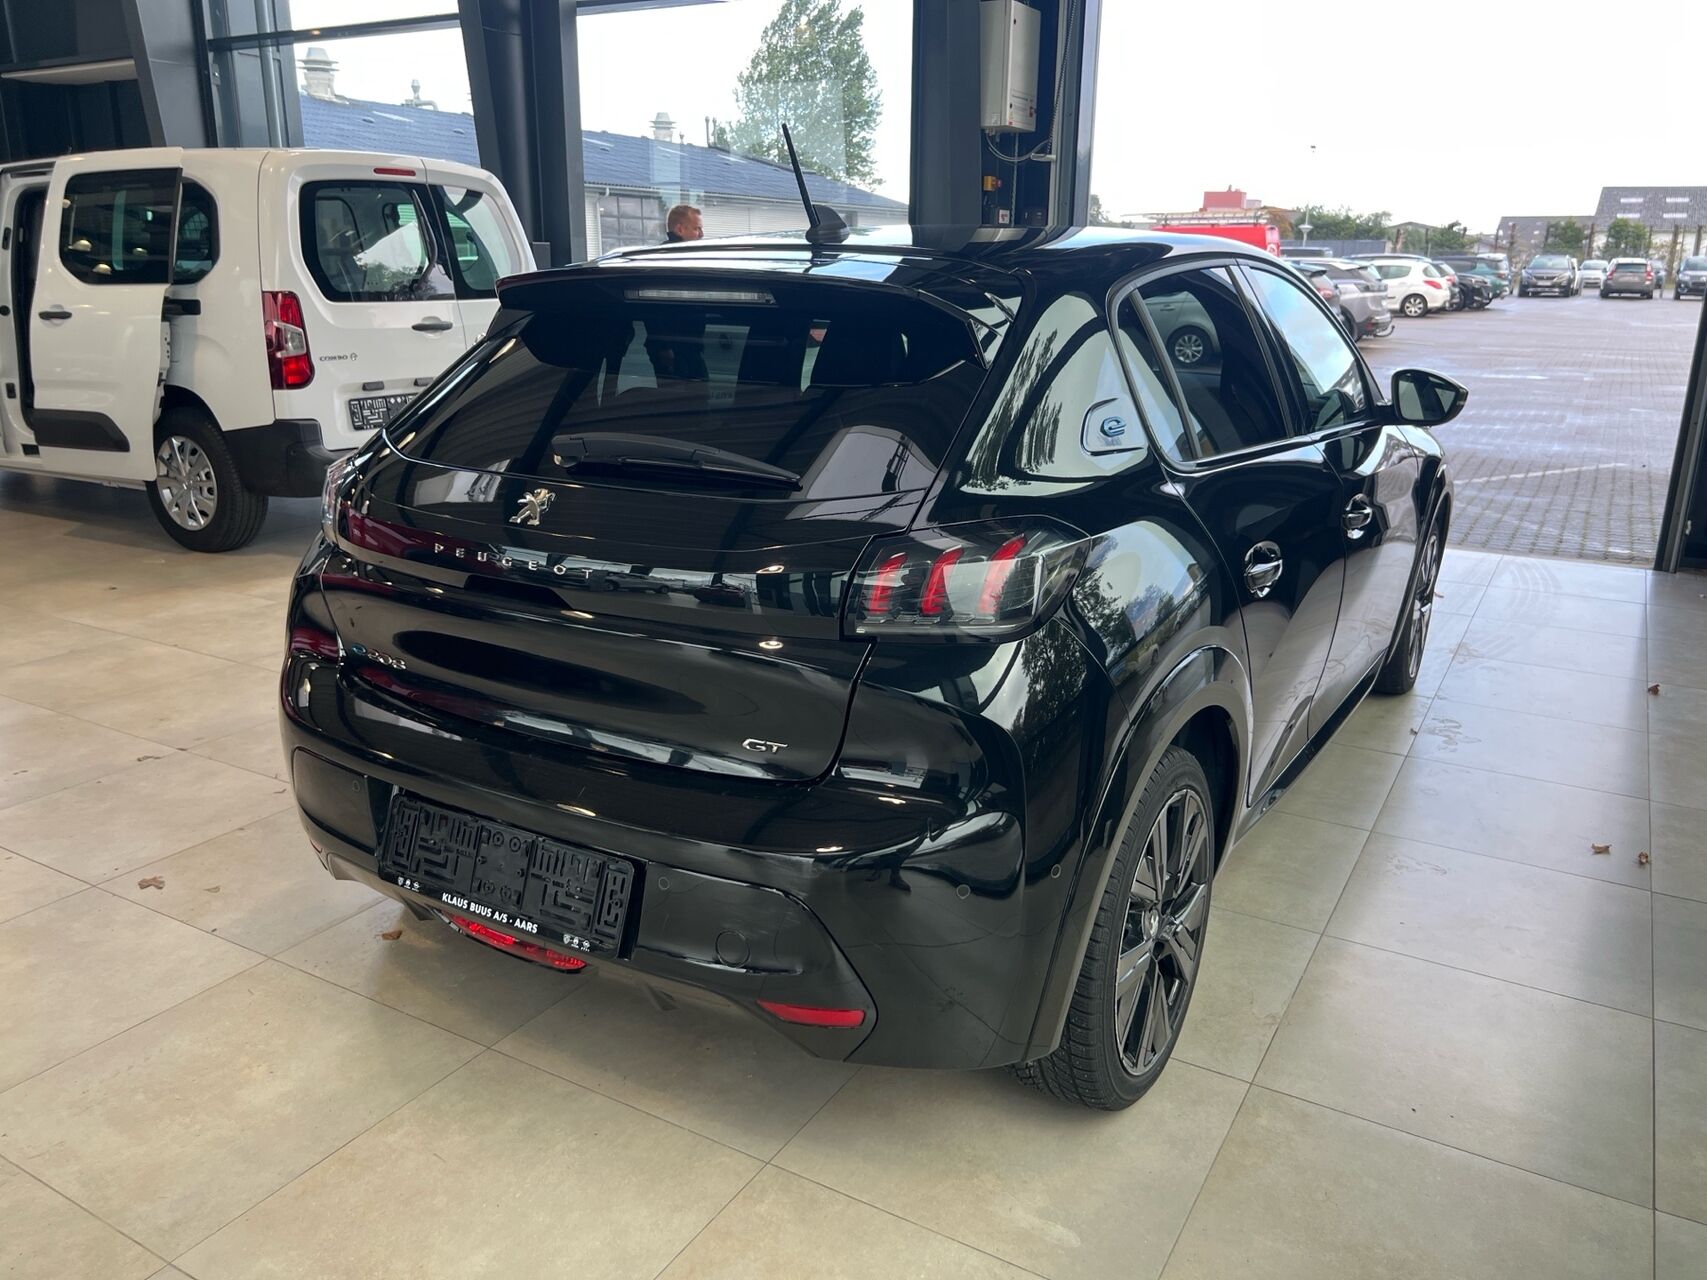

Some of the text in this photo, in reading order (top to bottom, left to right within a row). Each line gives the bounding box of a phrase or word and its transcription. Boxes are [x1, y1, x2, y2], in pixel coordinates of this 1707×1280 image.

[434, 542, 593, 579] PEUGEOT
[742, 738, 789, 753] GT
[441, 892, 539, 934] KLAUS BUUS A/S AARS
